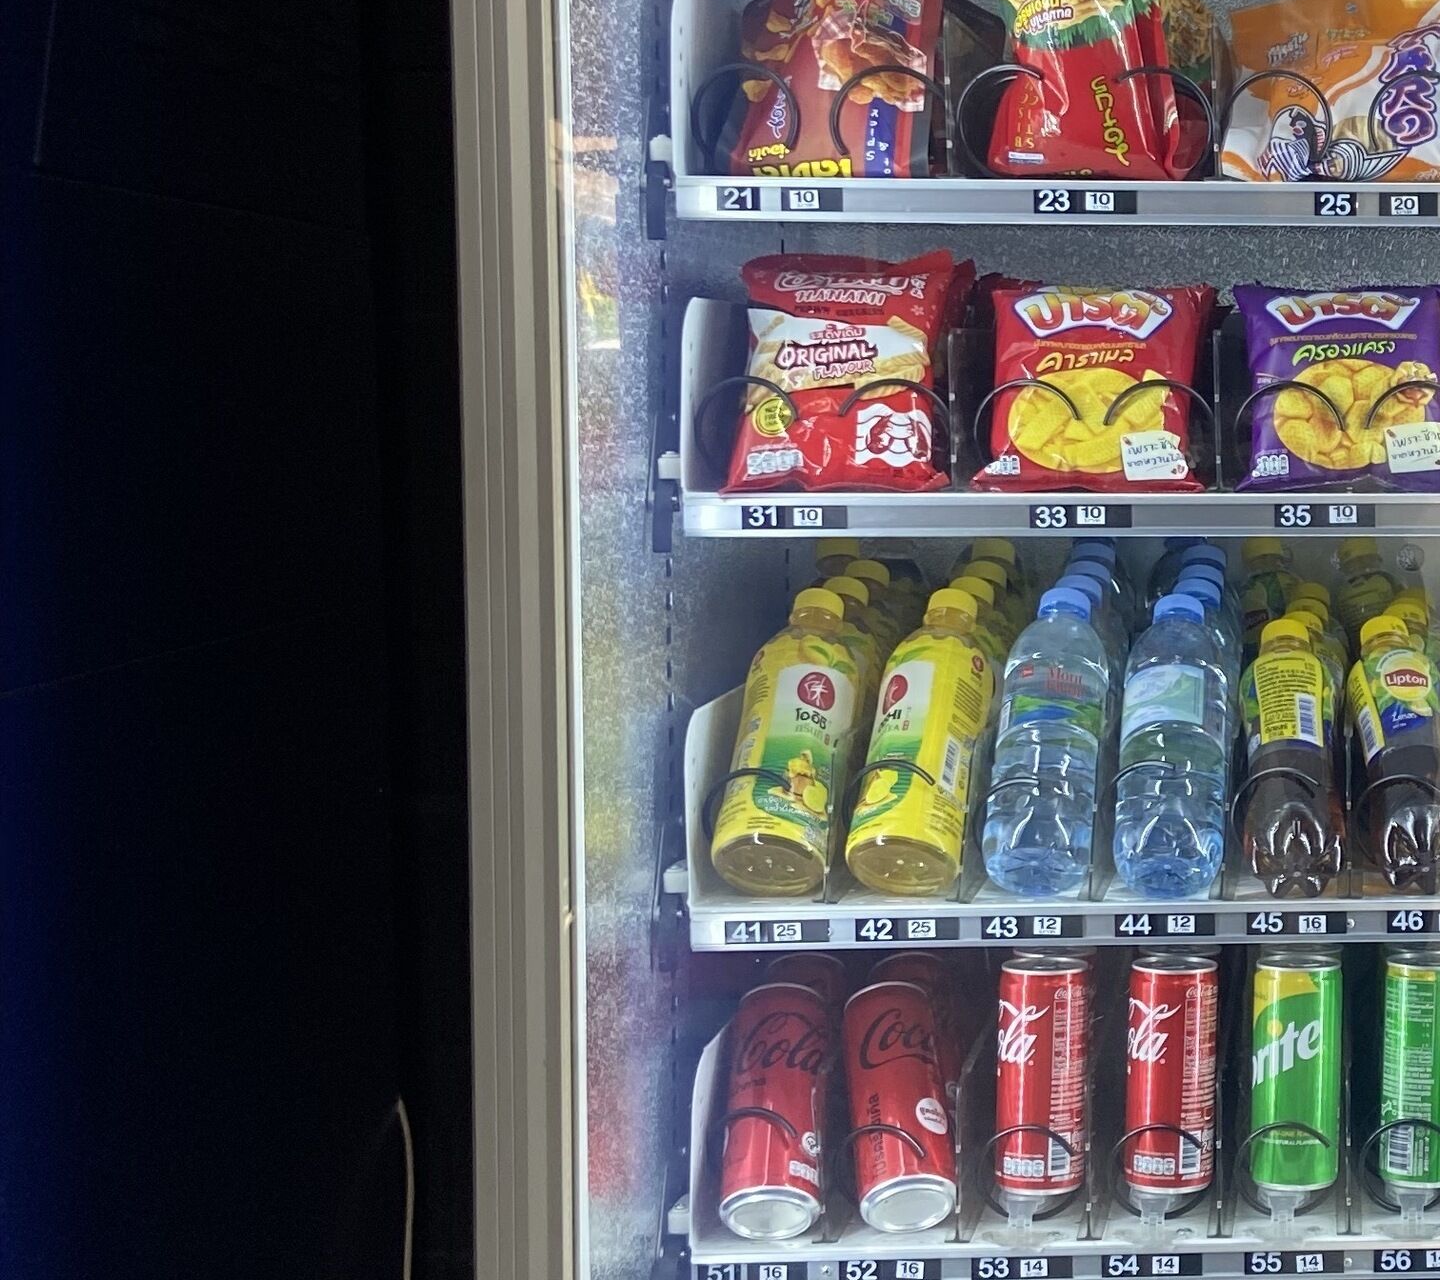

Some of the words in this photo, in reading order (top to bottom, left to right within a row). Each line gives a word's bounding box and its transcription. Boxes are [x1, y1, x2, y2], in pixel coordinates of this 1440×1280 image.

[724, 188, 753, 209] 21
[793, 191, 814, 203] 10
[1320, 194, 1351, 215] 25
[1394, 198, 1415, 211] 20
[795, 289, 886, 306] HANAMI
[777, 341, 874, 368] ORIGINAL
[1036, 349, 1134, 371] คาราเมล
[1292, 341, 1396, 365] ครองแครง
[748, 506, 777, 526] 31
[799, 510, 819, 521] 10
[1280, 505, 1311, 526] 35
[1333, 506, 1354, 517] 10
[1386, 674, 1427, 687] Lipton
[731, 922, 761, 942] 41
[776, 925, 796, 937] 25
[1251, 912, 1283, 933] 45
[1303, 916, 1321, 928] 16
[763, 1266, 782, 1279] 16
